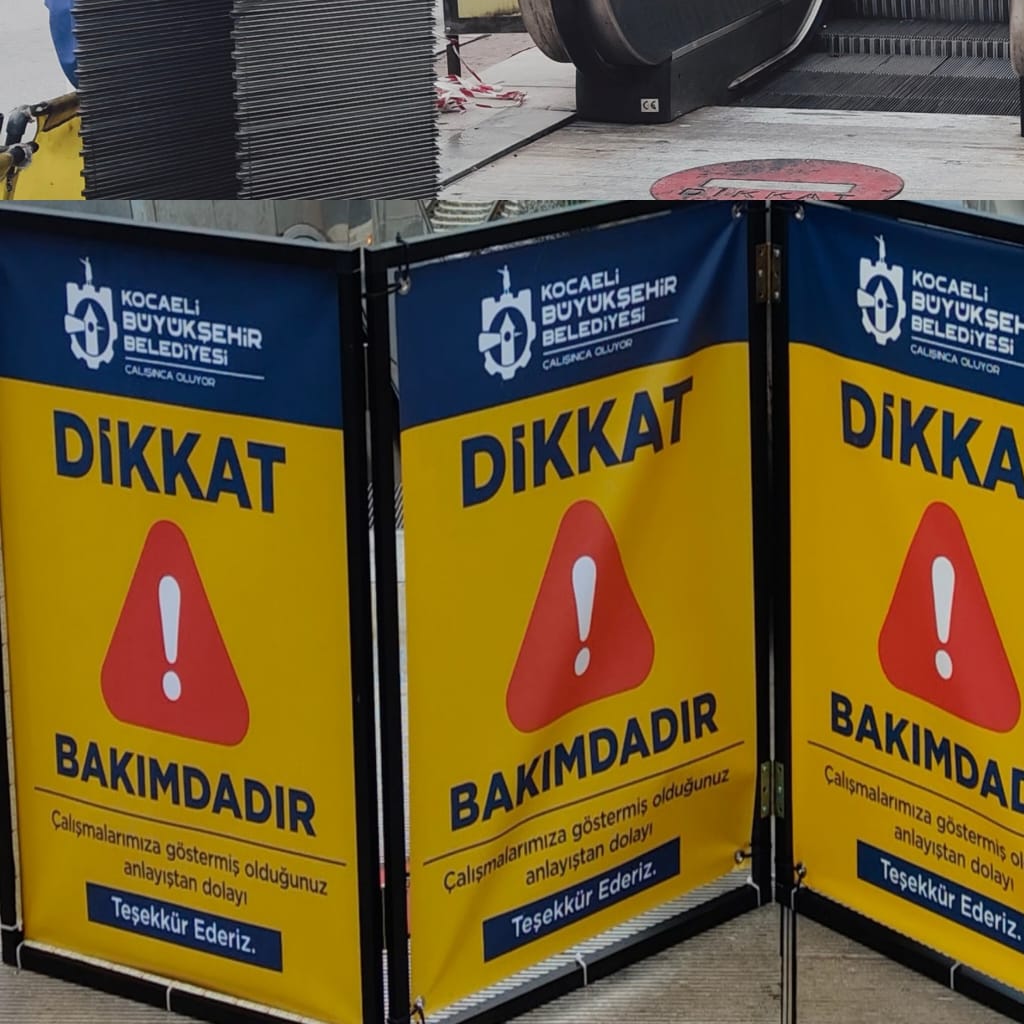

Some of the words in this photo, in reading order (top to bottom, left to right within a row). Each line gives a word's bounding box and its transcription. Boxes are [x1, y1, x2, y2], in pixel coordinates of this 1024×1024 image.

[121, 289, 200, 316] KOCAELİ
[541, 268, 619, 302] KOCAELİ
[542, 276, 678, 325] BÜYÜKŞEHİR
[912, 269, 988, 303] KOCAELİ
[122, 311, 263, 350] BÜYÜKŞEHİR
[124, 336, 228, 366] BELEDİYESİ
[542, 306, 646, 347] BELEDİYESİ
[594, 338, 633, 356] OLUYOR
[911, 315, 1015, 356] BELEDİYESİ
[175, 372, 216, 387] OLUYOR
[960, 356, 1001, 375] OLUYOR
[52, 409, 286, 514] DİKKAT
[461, 377, 694, 509] DİKKAT
[55, 732, 317, 837] BAKIMDADIR
[450, 692, 719, 832] BAKIMDADIR
[443, 828, 567, 893] Çalışmalarımıza
[572, 797, 648, 842] göstermiş
[653, 768, 730, 808] olduğunuz
[824, 765, 932, 825] Çalışmalarımıza
[936, 815, 1006, 861] göstermiş
[51, 809, 161, 855] Çalışmalarımıza
[166, 841, 240, 877] göstermiş
[245, 861, 328, 896] olduğunuz
[526, 836, 604, 886] anlayıştan
[609, 823, 653, 853] dolayı
[894, 825, 966, 867] anlayıştan
[970, 853, 1015, 891] dolayı
[123, 860, 197, 892] anlayıştan
[202, 877, 248, 907] dolayı
[511, 890, 592, 938] Teşekkür
[598, 859, 657, 901] Ederiz.
[880, 858, 955, 910] Teşekkür
[961, 897, 1022, 941] Ederiz.
[111, 895, 188, 936] Teşekkür
[194, 918, 257, 954] Ederiz.
